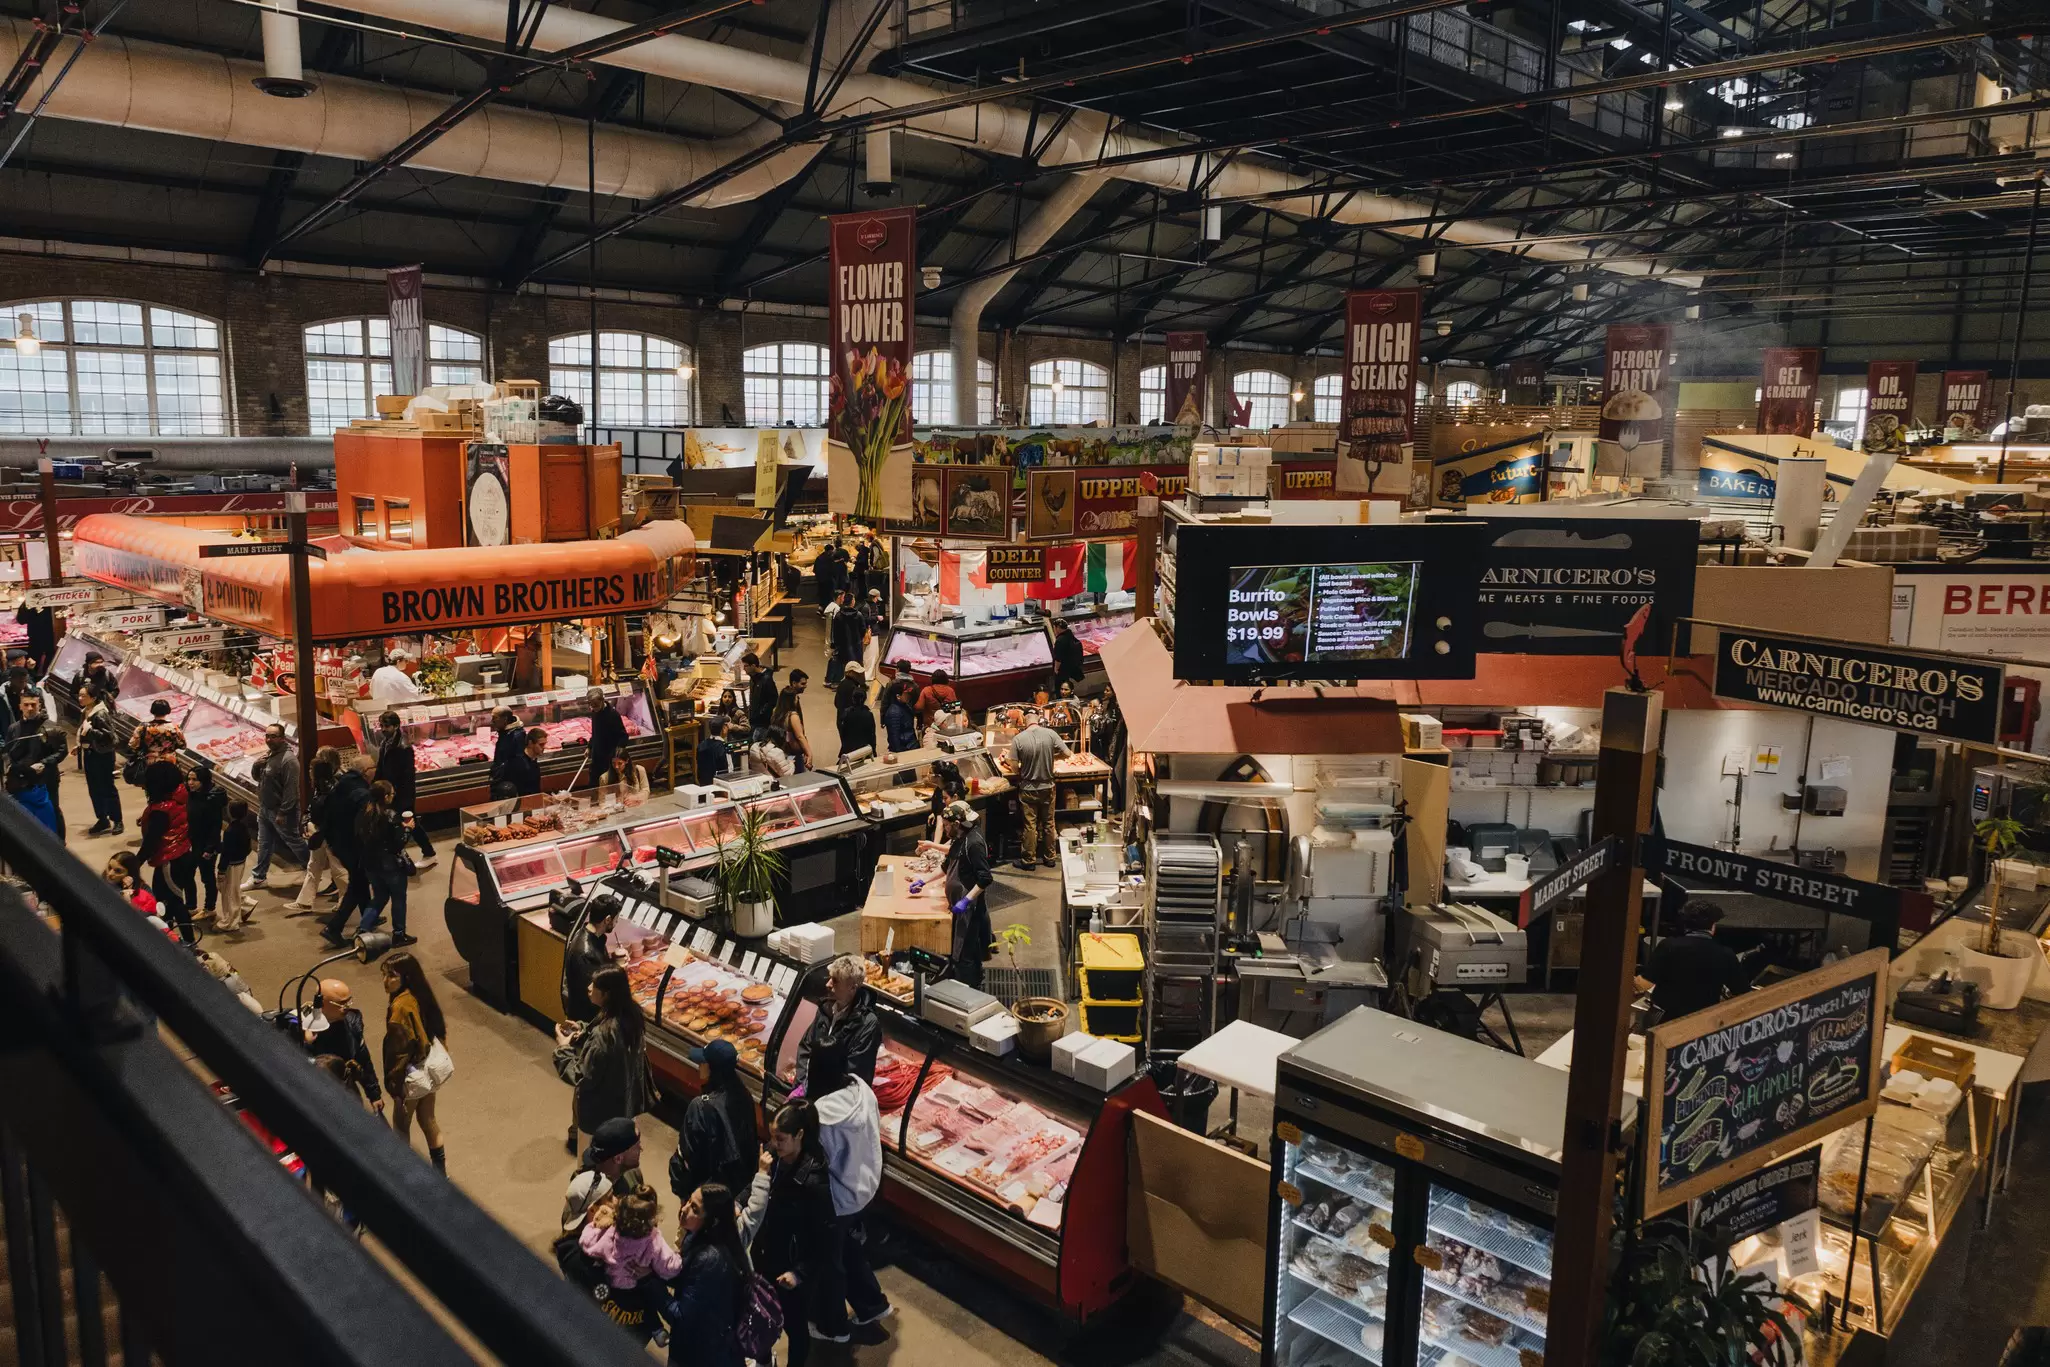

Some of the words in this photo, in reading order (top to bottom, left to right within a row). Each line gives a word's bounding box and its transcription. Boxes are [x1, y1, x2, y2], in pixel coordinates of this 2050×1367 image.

[840, 261, 904, 301] FLOWER
[392, 297, 419, 331] STALK
[841, 302, 904, 343] POWER
[1353, 322, 1412, 363] HIGH
[1170, 350, 1202, 362] HAMMING
[1612, 349, 1663, 369] PEROGY
[1174, 363, 1183, 379] IT
[1184, 363, 1197, 379] UP
[1351, 364, 1409, 390] STEAKS
[1778, 366, 1803, 385] GET
[1610, 369, 1661, 391] PARTY
[1878, 376, 1904, 397] OH,
[1766, 385, 1811, 399] CRACKIN'
[1948, 384, 1981, 400] MAKI
[1870, 397, 1908, 410] SHUCKS
[1946, 400, 1960, 411] MY
[1962, 400, 1979, 411] DAY
[1285, 471, 1332, 488] UPPER
[1709, 475, 1774, 497] BAKER
[227, 546, 249, 555] MAIN
[251, 544, 282, 554] STREET
[991, 549, 1041, 564] DELI
[990, 568, 1041, 580] COUNTER
[1480, 567, 1656, 586] ARNICERO'S
[49, 590, 91, 601] CHICKEN
[382, 586, 484, 625] BROWN
[495, 574, 624, 615] BROTHERS
[1229, 588, 1286, 603] Burrito
[1504, 594, 1546, 604] MEATS
[1555, 595, 1563, 604] &
[1572, 595, 1602, 604] FINE
[1612, 595, 1655, 605] FOODS
[122, 613, 152, 624] PORK
[1228, 608, 1279, 622] Bowls
[177, 633, 211, 645] LAMB
[1227, 627, 1284, 642] $19.99
[315, 661, 343, 677] Bacon
[1731, 638, 1984, 702] CARNICERO'S
[1746, 668, 1858, 701] MERCADO
[1869, 687, 1956, 719] LUNCH
[1757, 687, 1938, 731] www.carnicero's.ca
[1533, 869, 1572, 910] MARKET
[1572, 848, 1606, 883] STREET
[1665, 848, 1748, 882] FRONT
[1756, 869, 1859, 907] STREET
